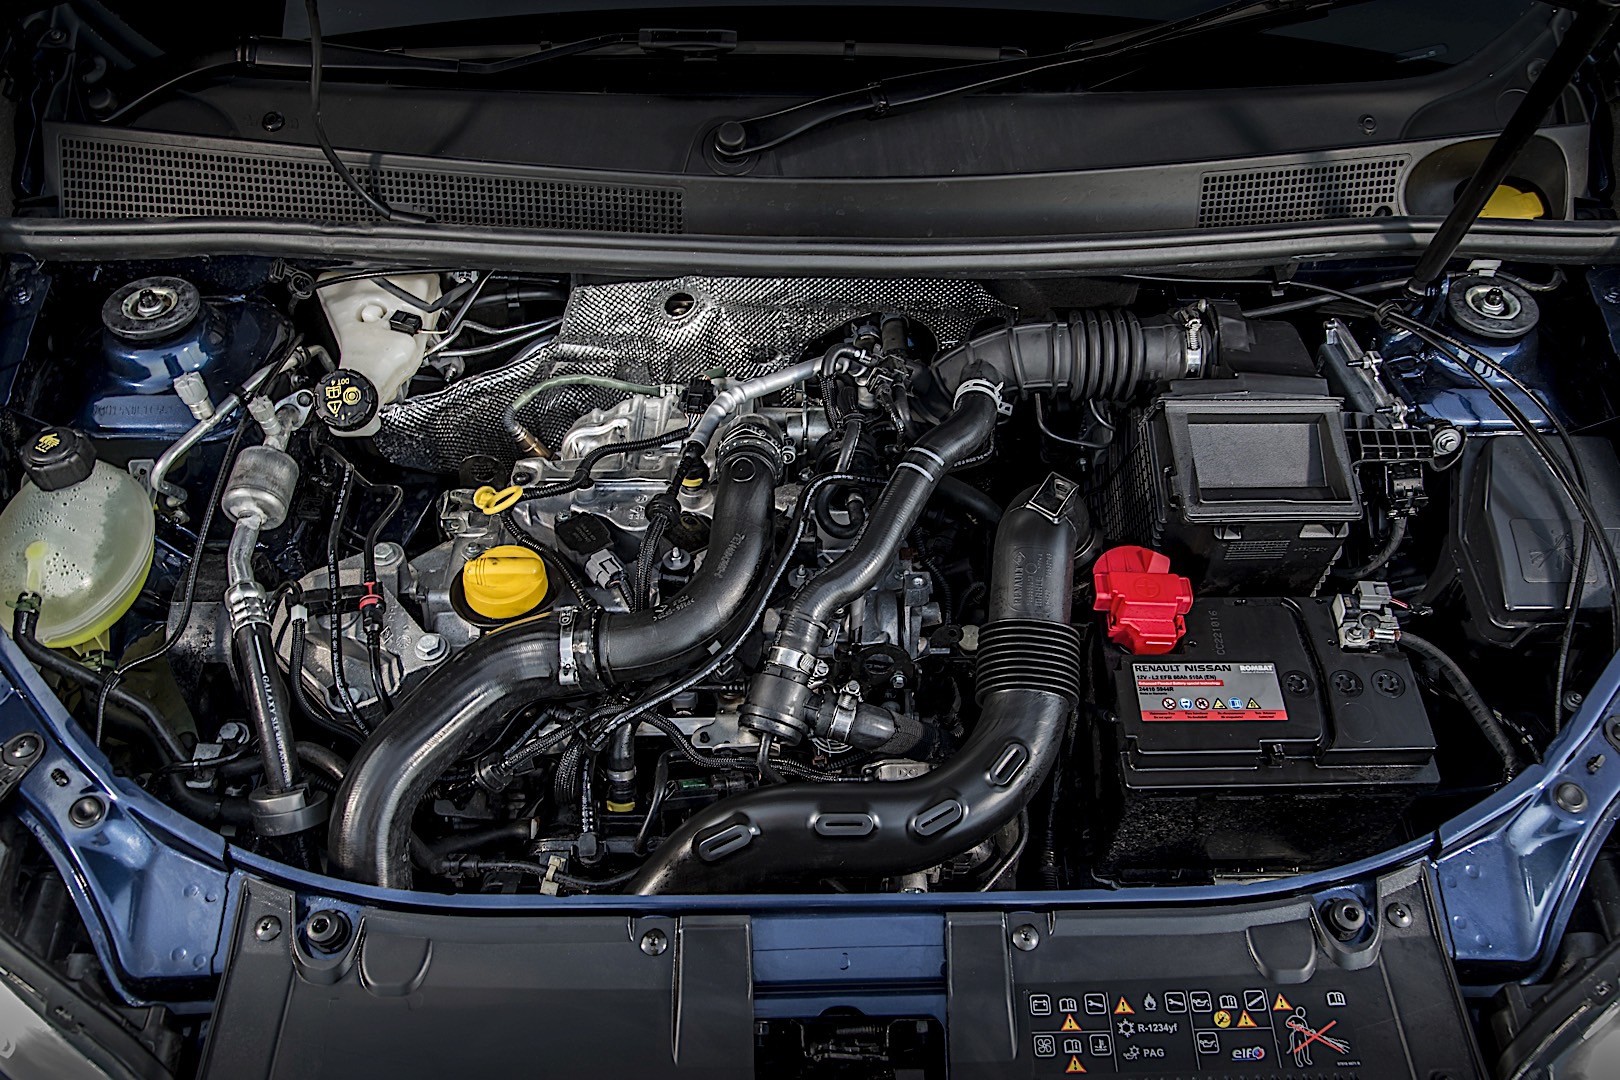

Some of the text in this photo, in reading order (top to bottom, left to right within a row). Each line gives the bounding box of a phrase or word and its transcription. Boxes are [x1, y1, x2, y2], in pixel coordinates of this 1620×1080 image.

[336, 377, 350, 386] DOT
[1013, 566, 1024, 606] RENAULT
[1134, 664, 1232, 672] RENAULT NISSAN
[262, 675, 277, 715] GALAXY
[282, 763, 292, 783] HOSE
[1137, 1022, 1178, 1034] R-1234yf
[1143, 1048, 1165, 1058] PAG
[1232, 1047, 1254, 1060] elf
